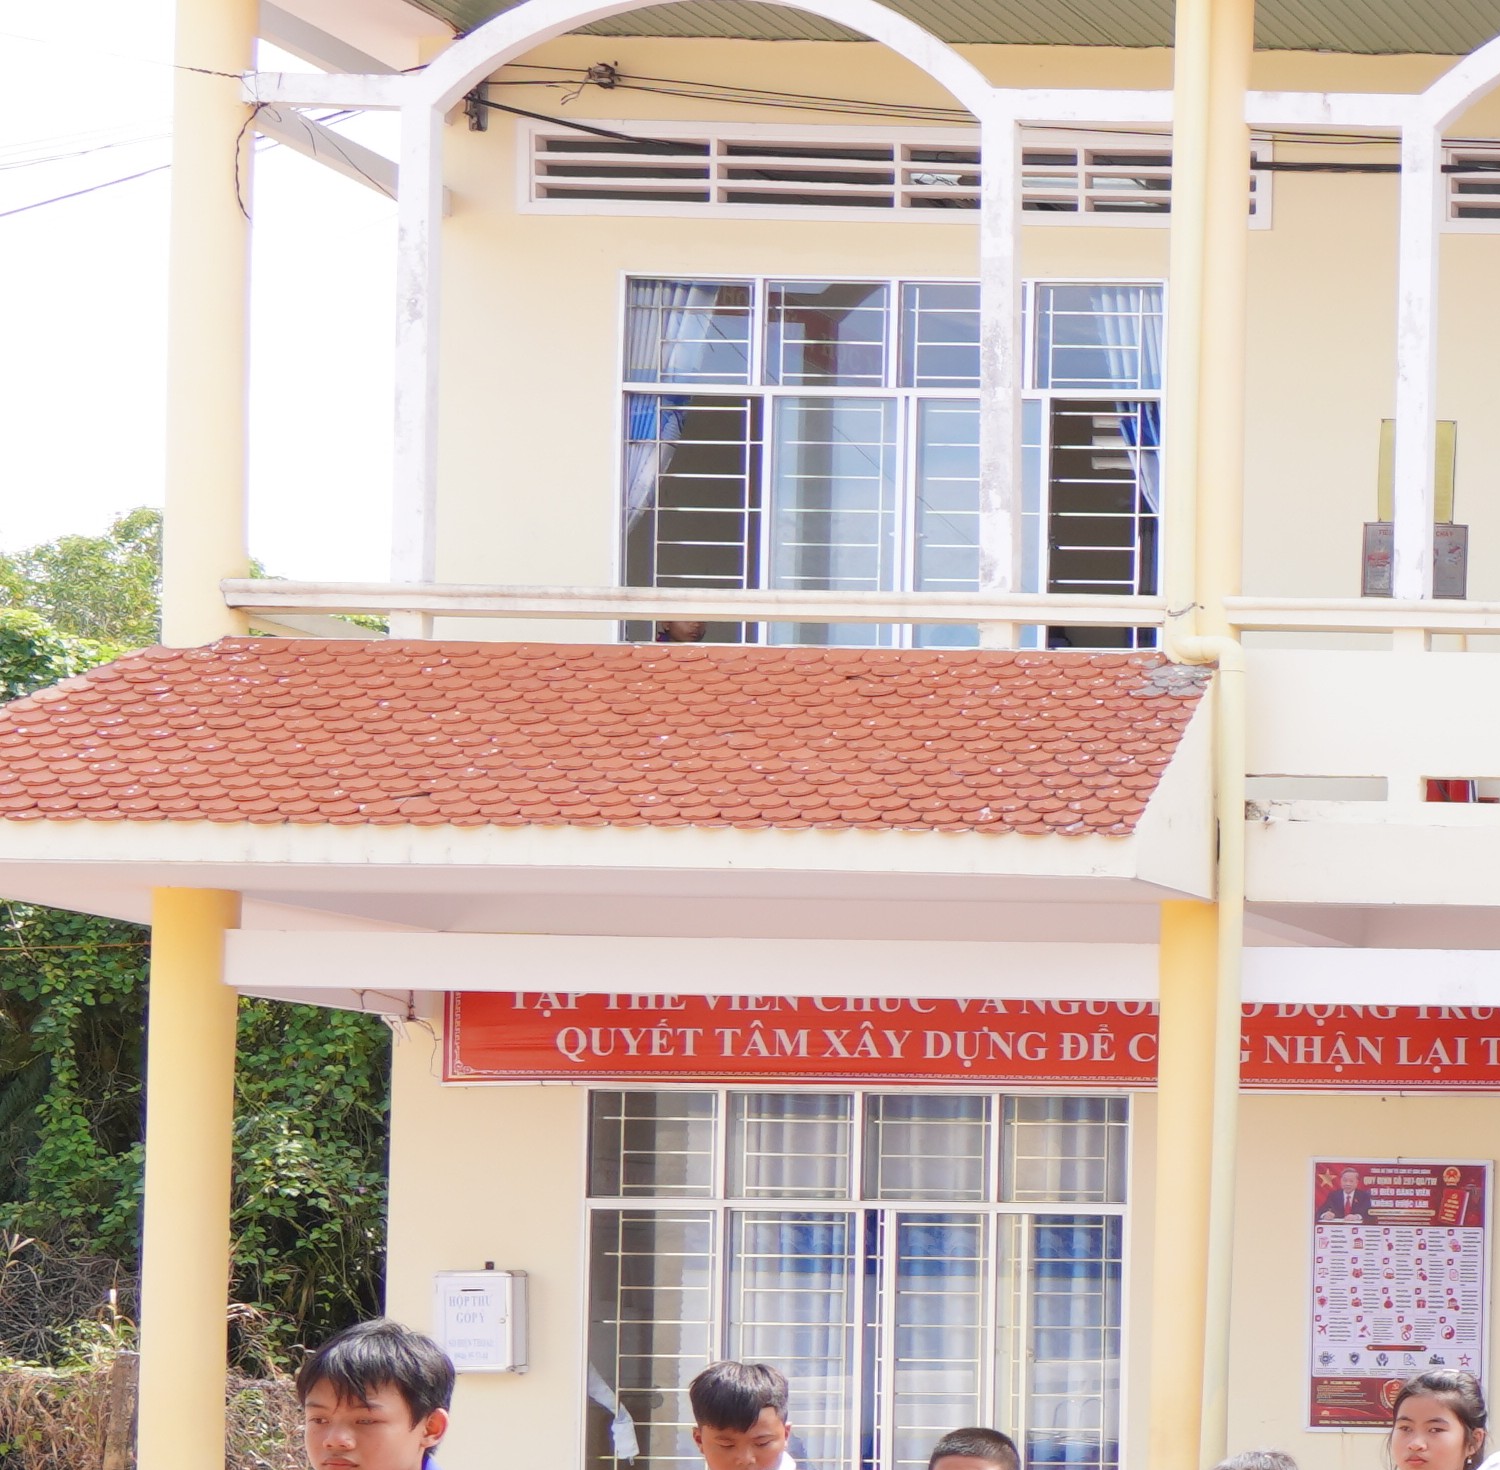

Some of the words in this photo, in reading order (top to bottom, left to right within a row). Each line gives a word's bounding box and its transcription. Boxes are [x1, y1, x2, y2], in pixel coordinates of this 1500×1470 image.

[556, 1018, 702, 1063] QUYẾT
[716, 1020, 809, 1057] TÂM
[823, 1021, 912, 1059] XÂY
[924, 1026, 1047, 1068] DỰNG
[1060, 1023, 1116, 1062] ĐỂ
[1264, 1031, 1383, 1073] NHẬN
[1397, 1037, 1467, 1075] LẠI
